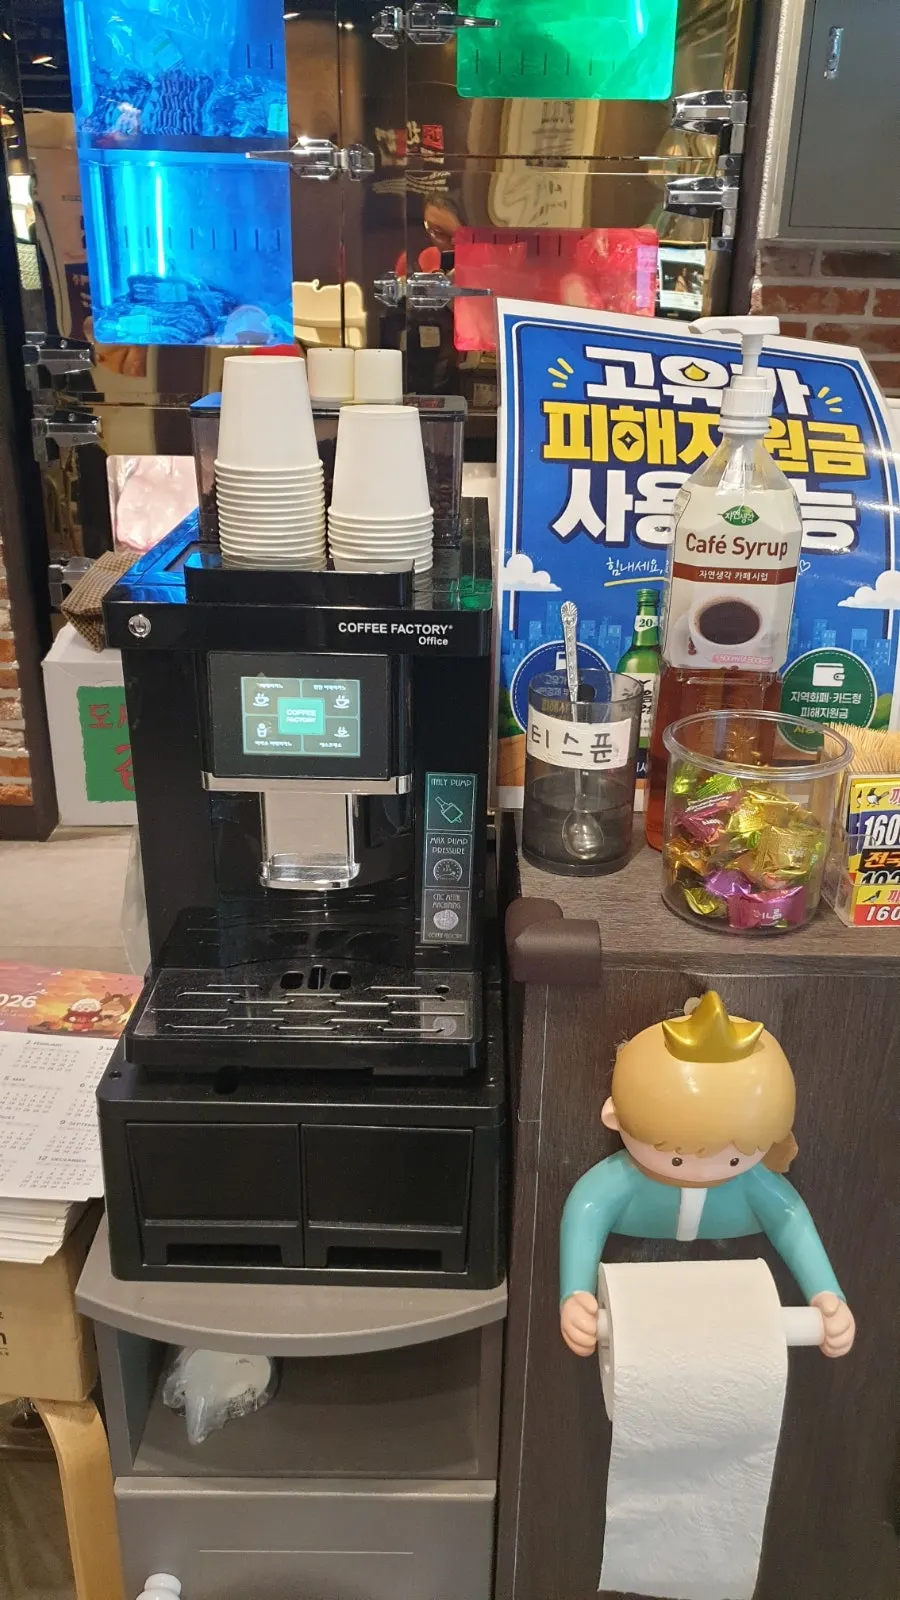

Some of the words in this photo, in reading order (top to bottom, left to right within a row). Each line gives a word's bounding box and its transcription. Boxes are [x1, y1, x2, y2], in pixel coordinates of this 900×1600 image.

[686, 532, 727, 553] Café
[732, 536, 788, 560] Syrup
[699, 570, 732, 580] 자연생각
[338, 622, 388, 633] COFFEE
[418, 636, 449, 646] Office
[801, 707, 849, 719] 피해지원금
[450, 779, 472, 787] PUMP
[447, 837, 468, 845] PUMP
[432, 846, 465, 855] PRESSURE
